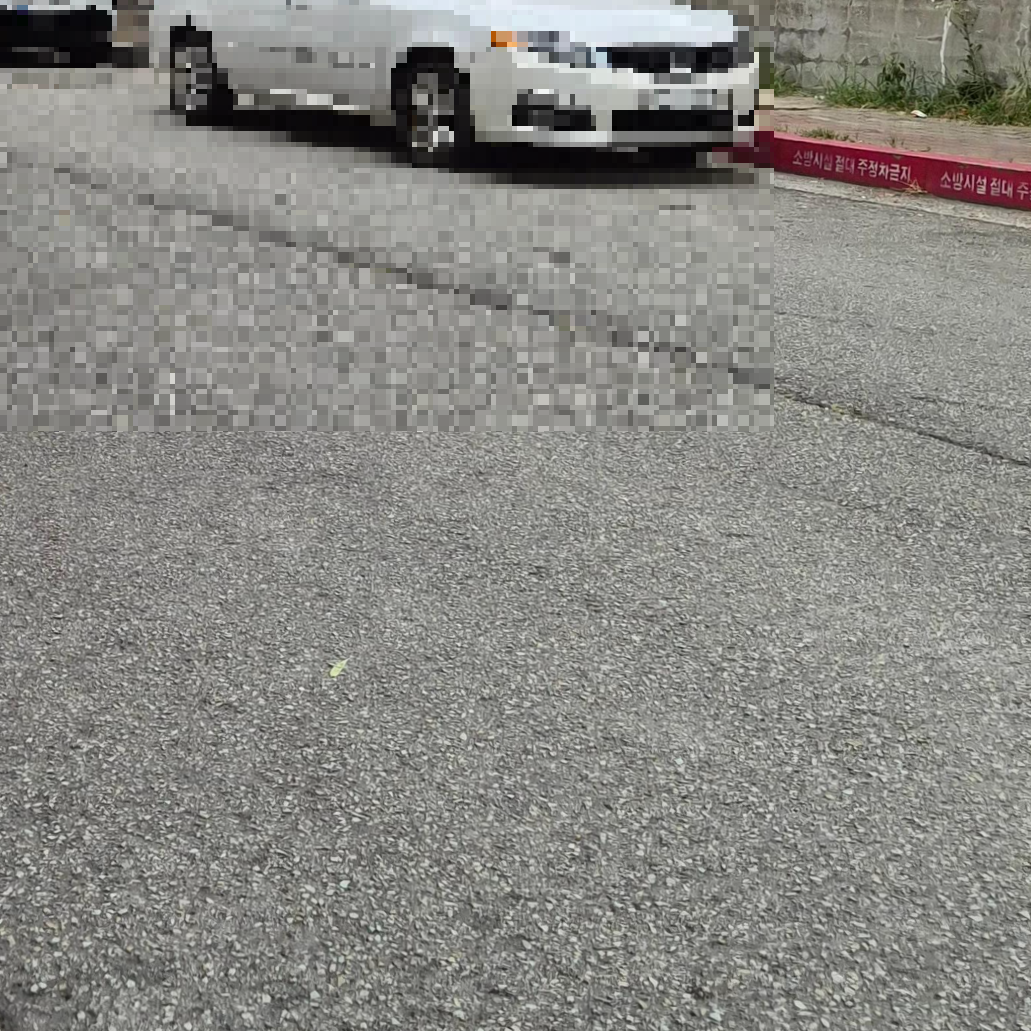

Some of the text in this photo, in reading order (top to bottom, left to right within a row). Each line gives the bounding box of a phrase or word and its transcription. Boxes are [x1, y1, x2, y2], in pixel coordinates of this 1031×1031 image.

[834, 154, 856, 175] 절대
[857, 158, 912, 183] 주정차금지
[940, 171, 1031, 201] 소방시설 절대 주
